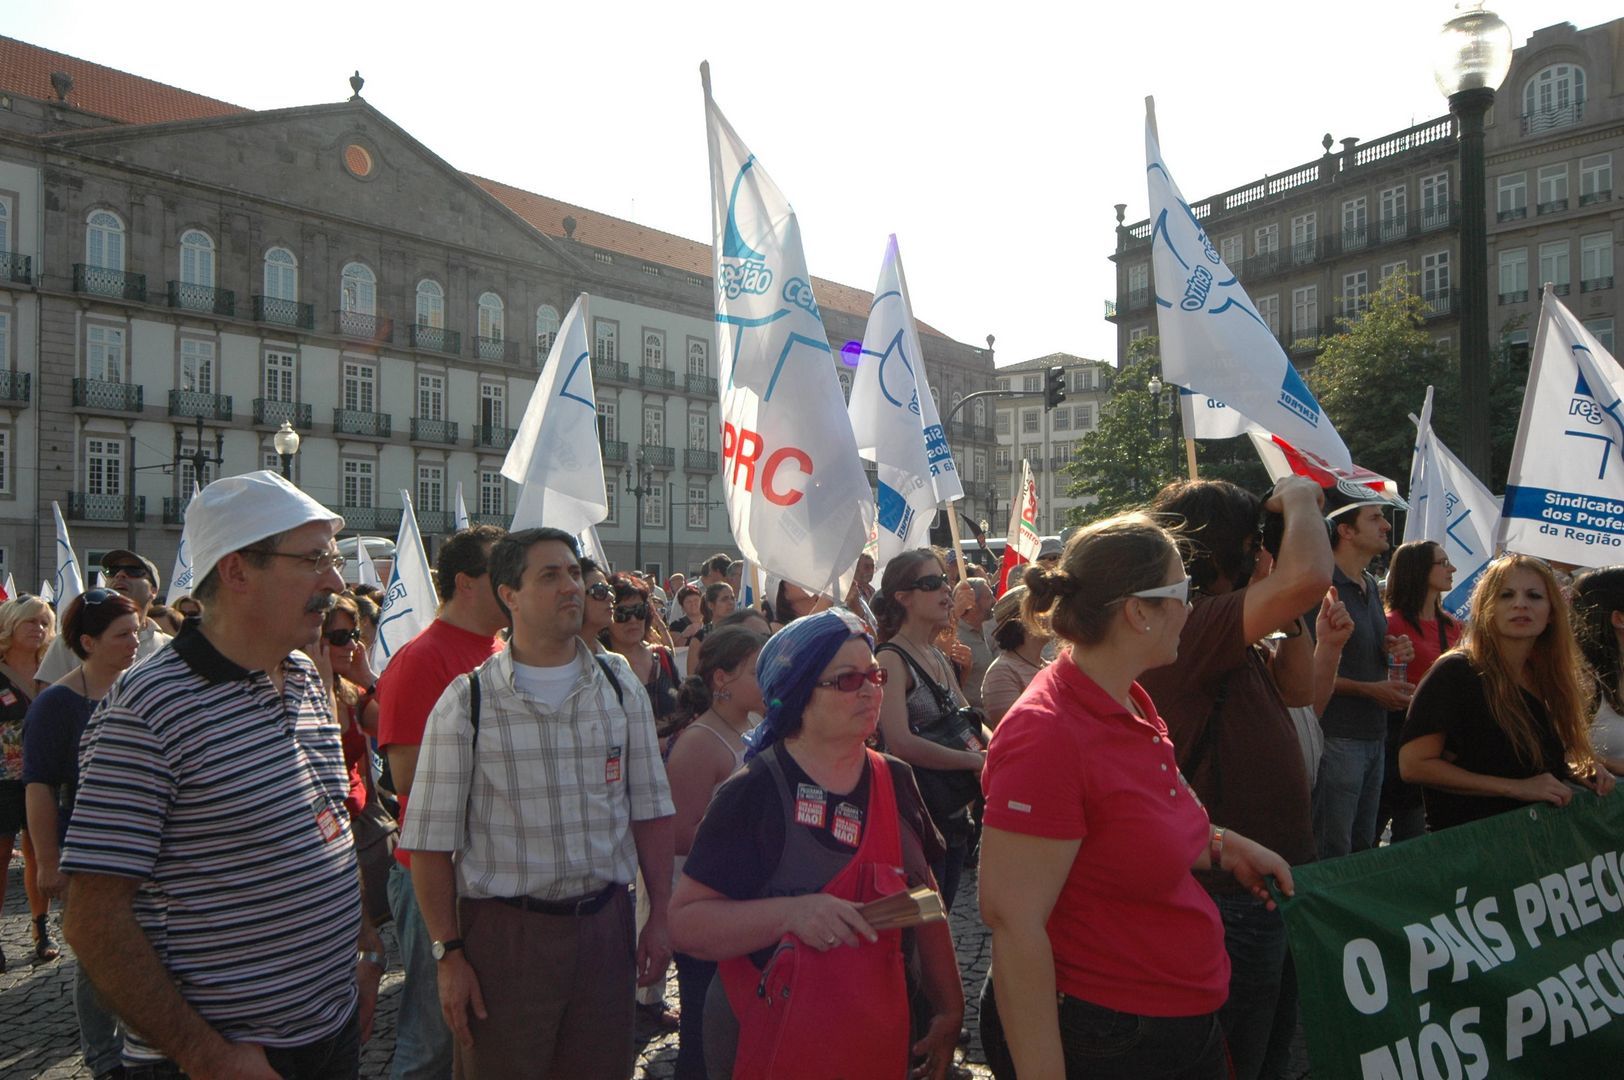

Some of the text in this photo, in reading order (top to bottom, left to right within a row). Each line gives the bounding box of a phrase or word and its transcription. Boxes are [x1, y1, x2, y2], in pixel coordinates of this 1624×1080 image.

[1544, 492, 1624, 514] Sindicato
[1542, 507, 1624, 530] dos Profe
[1539, 524, 1621, 547] da Região
[1343, 851, 1624, 1014] O PAÍS PRECI
